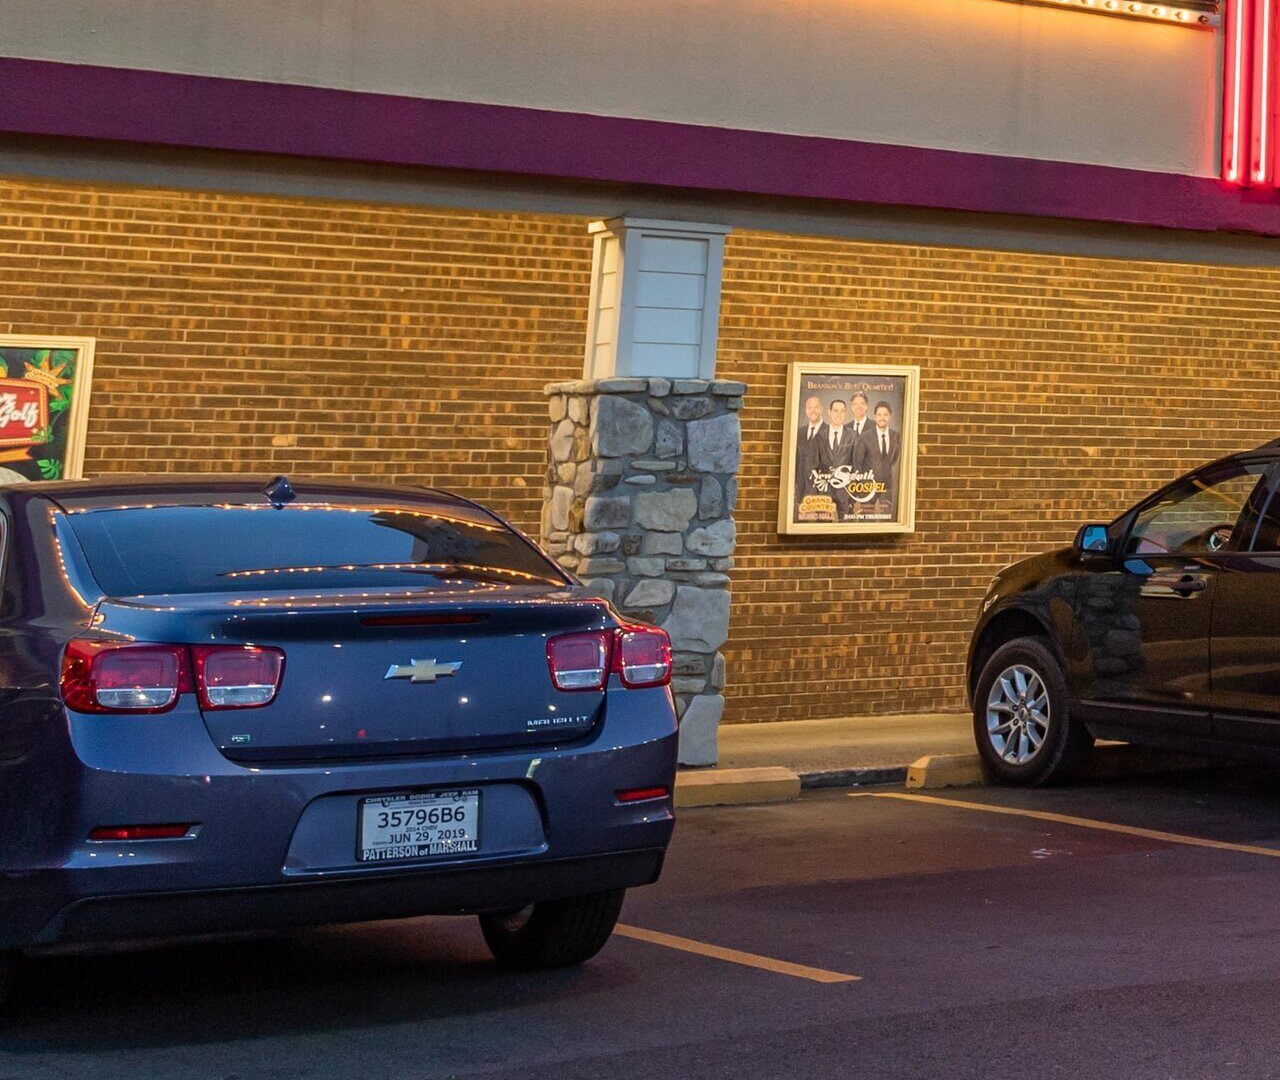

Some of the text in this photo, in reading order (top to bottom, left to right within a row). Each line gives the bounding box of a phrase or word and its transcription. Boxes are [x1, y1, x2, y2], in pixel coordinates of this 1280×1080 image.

[848, 482, 887, 493] GOSPEL
[378, 806, 465, 829] 35796B6
[388, 833, 411, 844] JUN
[415, 831, 433, 842] 29,
[437, 828, 465, 840] 2019
[363, 846, 419, 861] PATTERSON
[429, 840, 478, 855] MARSHALL
